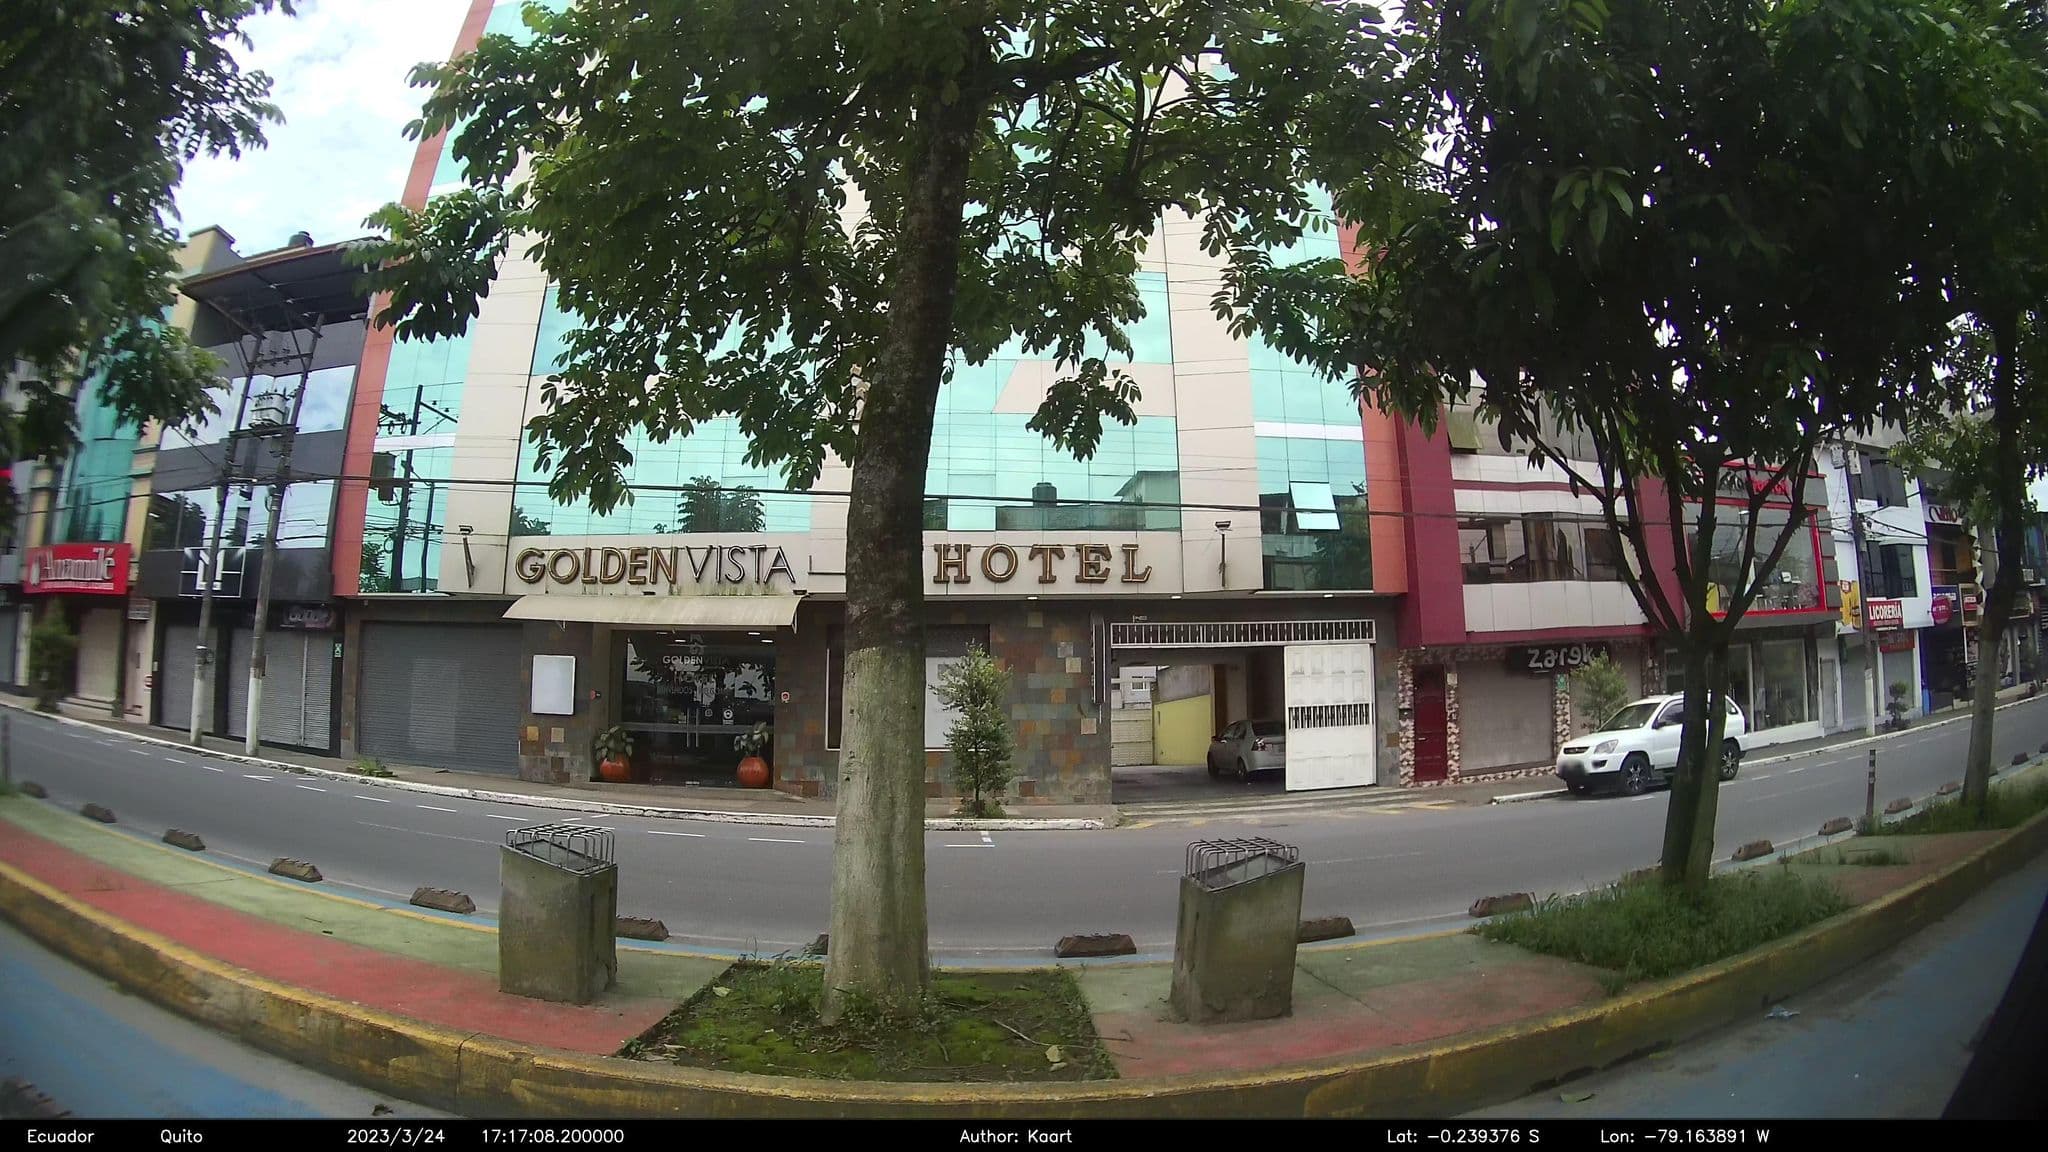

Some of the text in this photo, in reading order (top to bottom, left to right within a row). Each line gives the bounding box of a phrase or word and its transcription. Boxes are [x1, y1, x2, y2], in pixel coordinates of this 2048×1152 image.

[515, 543, 1153, 584] GOLDEN VISTA HOTEL
[662, 655, 703, 665] GOLDEN
